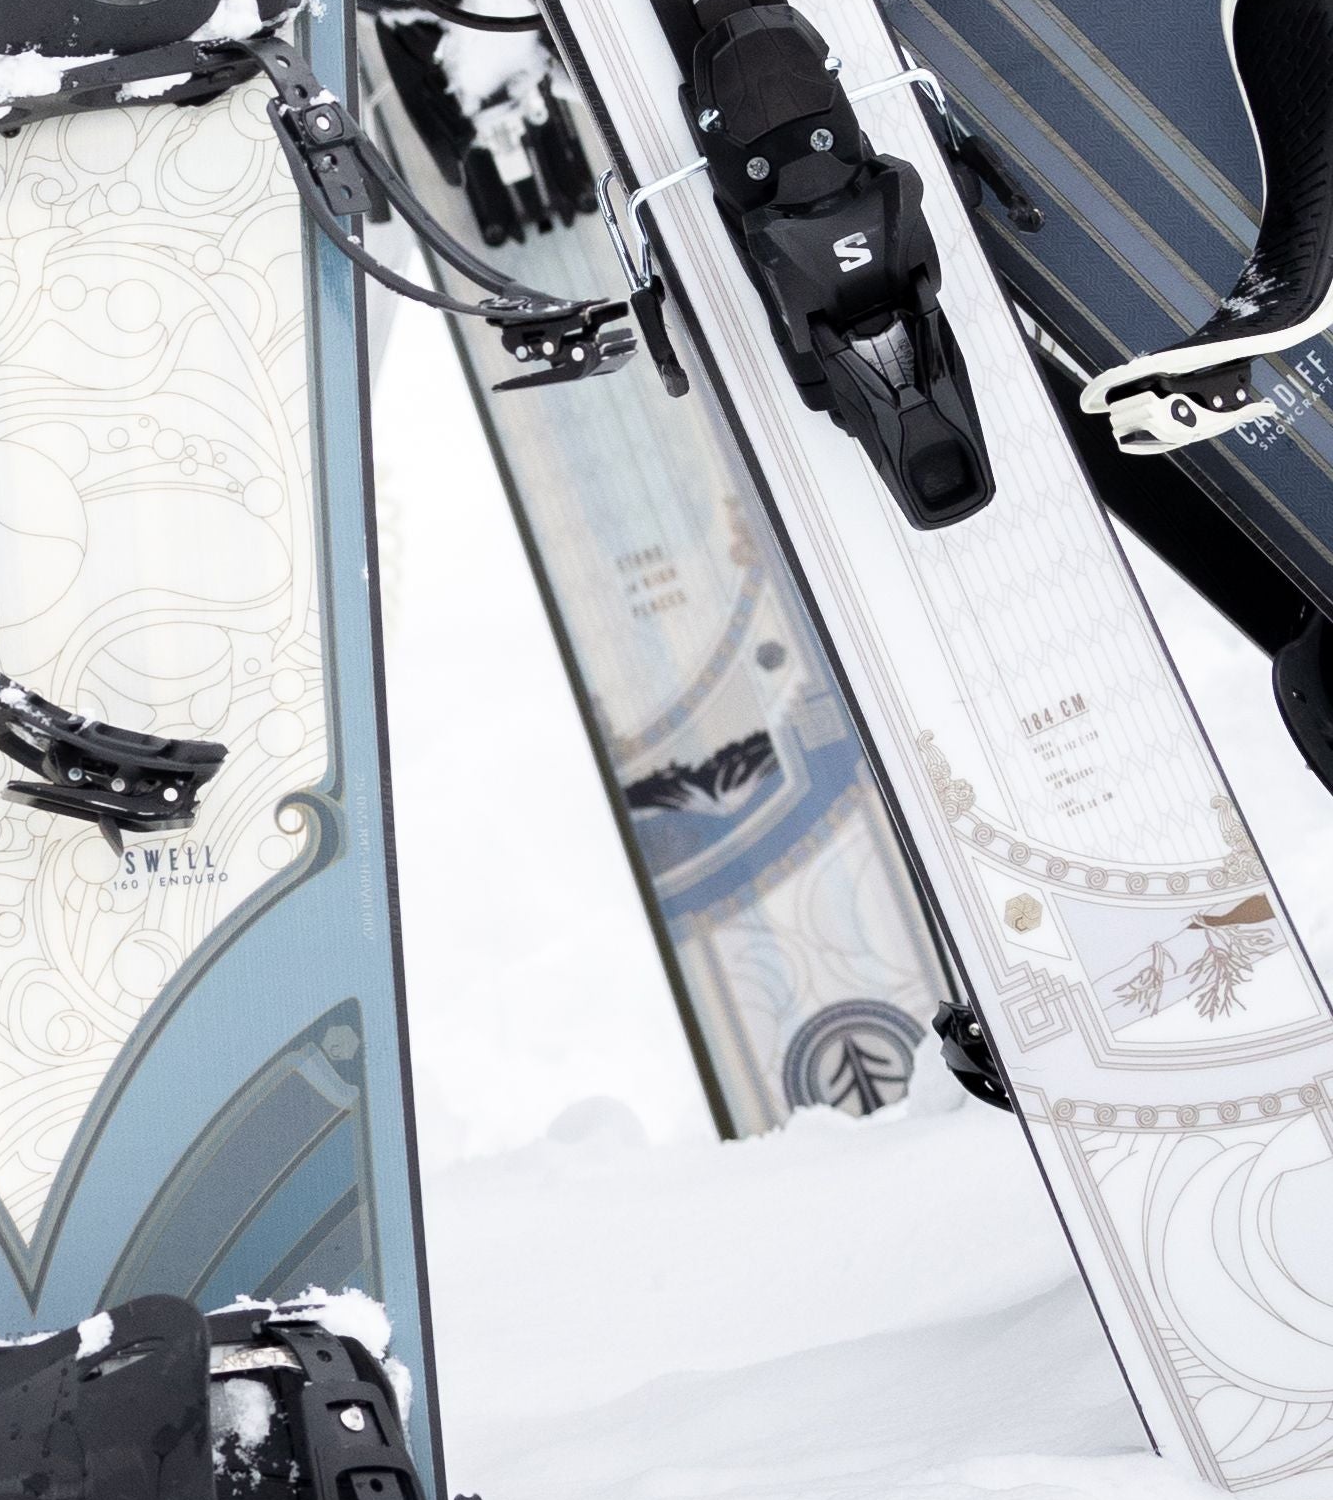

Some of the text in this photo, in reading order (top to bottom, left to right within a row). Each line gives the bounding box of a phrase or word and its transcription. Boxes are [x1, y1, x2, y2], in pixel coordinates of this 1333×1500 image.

[1235, 349, 1327, 445] CARDIFF
[1258, 375, 1333, 451] SNOWCRAFT
[1021, 692, 1086, 735] 184 CM
[113, 871, 230, 892] 160 ENDURO
[124, 844, 216, 876] SWELL
